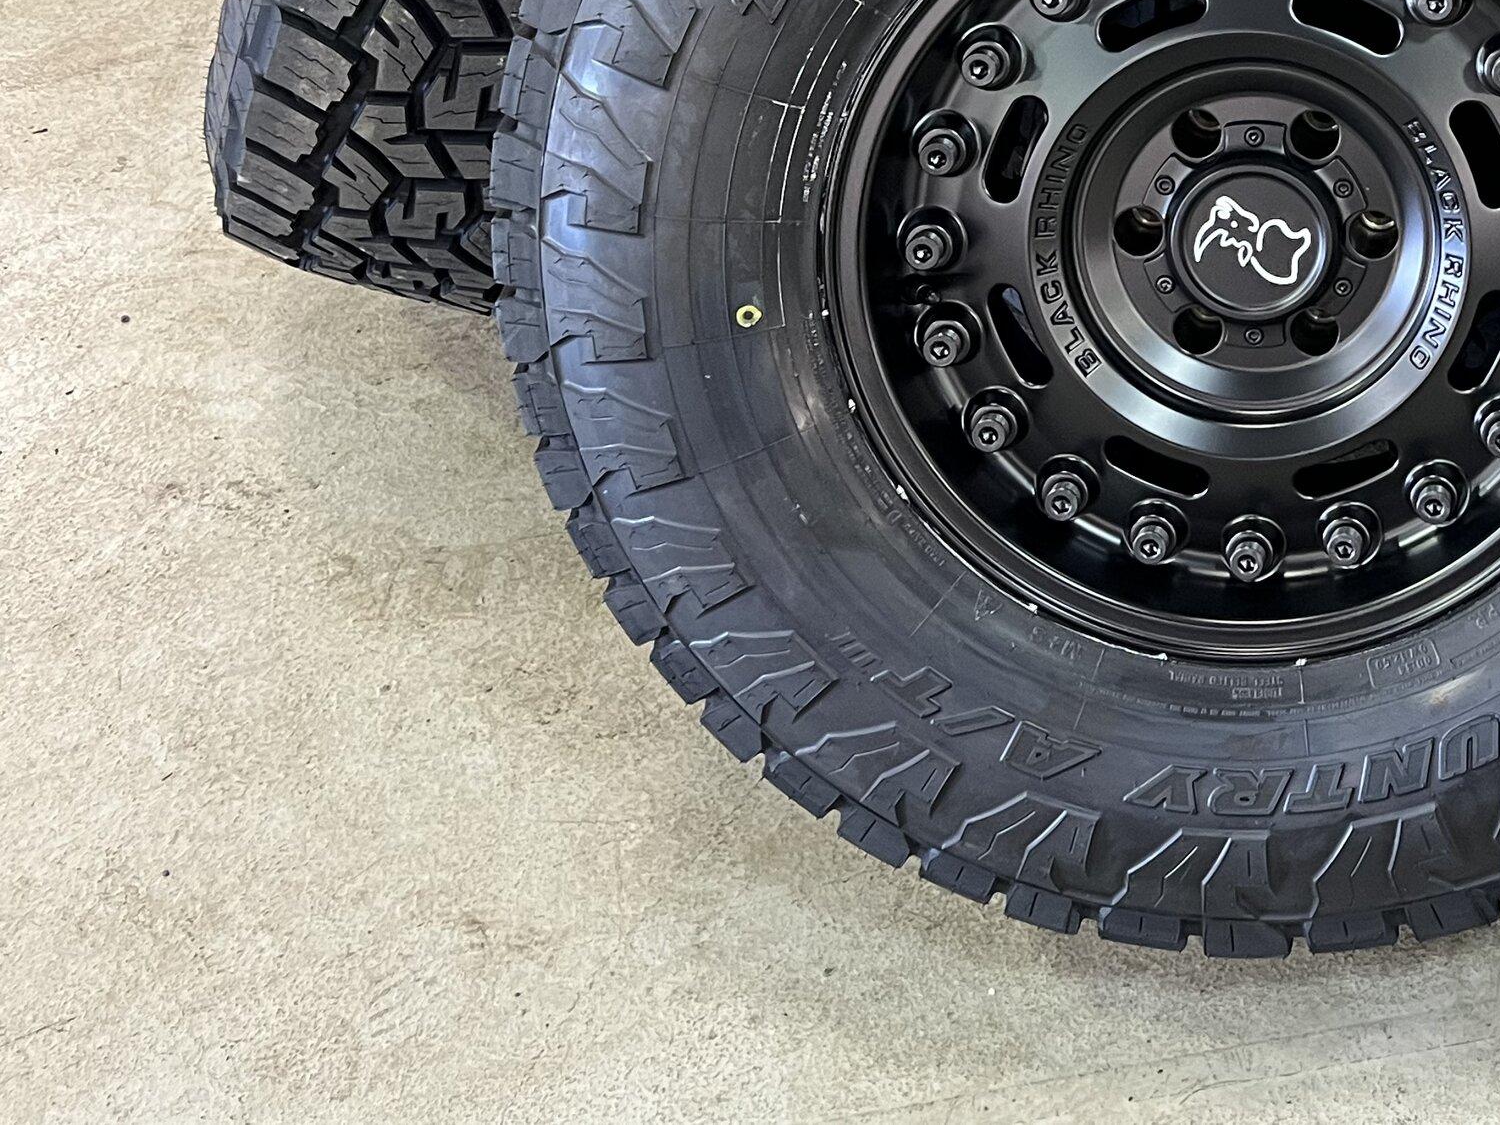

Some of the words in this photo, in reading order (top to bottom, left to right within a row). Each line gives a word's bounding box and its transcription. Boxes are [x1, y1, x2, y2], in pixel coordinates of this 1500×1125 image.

[1033, 121, 1089, 241] RHINO
[1402, 118, 1466, 244] BLACK
[1036, 248, 1103, 378] BLACK
[1408, 263, 1464, 372] RHINO
[874, 663, 1103, 780] A/T
